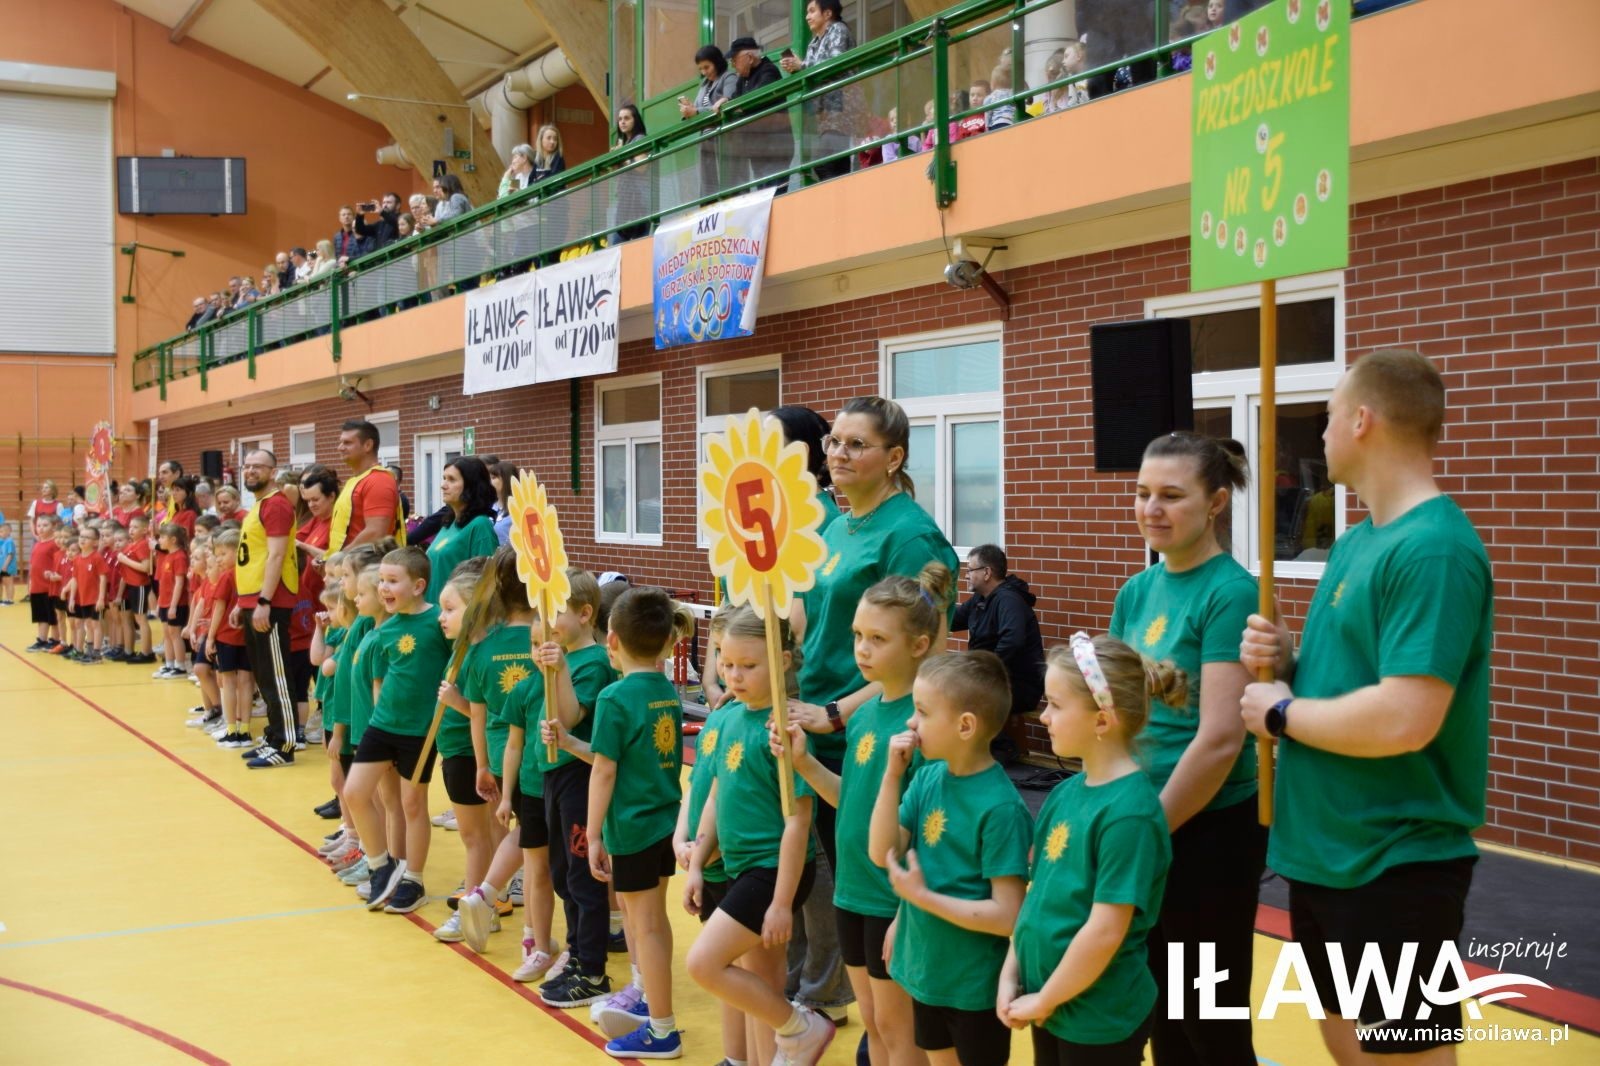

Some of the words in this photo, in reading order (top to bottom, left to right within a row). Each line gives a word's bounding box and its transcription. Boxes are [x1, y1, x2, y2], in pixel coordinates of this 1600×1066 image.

[1196, 34, 1338, 135] PRZEDSZKOLE
[1223, 166, 1250, 219] NR
[1261, 131, 1286, 212] 5
[697, 212, 719, 235] XXV
[658, 239, 760, 279] MIĘDZYPRZEDSZKOLN
[662, 269, 705, 299] IGRZYSKA
[707, 264, 754, 281] SPORTOW
[468, 296, 524, 346] IŁAWA
[537, 273, 606, 329] IŁAWA
[483, 347, 493, 365] od
[495, 341, 520, 372] 720
[521, 340, 532, 357] lat
[555, 330, 567, 350] od
[569, 324, 600, 358] 720
[525, 513, 552, 582] 5
[736, 478, 778, 572] 5
[663, 724, 671, 743] 5
